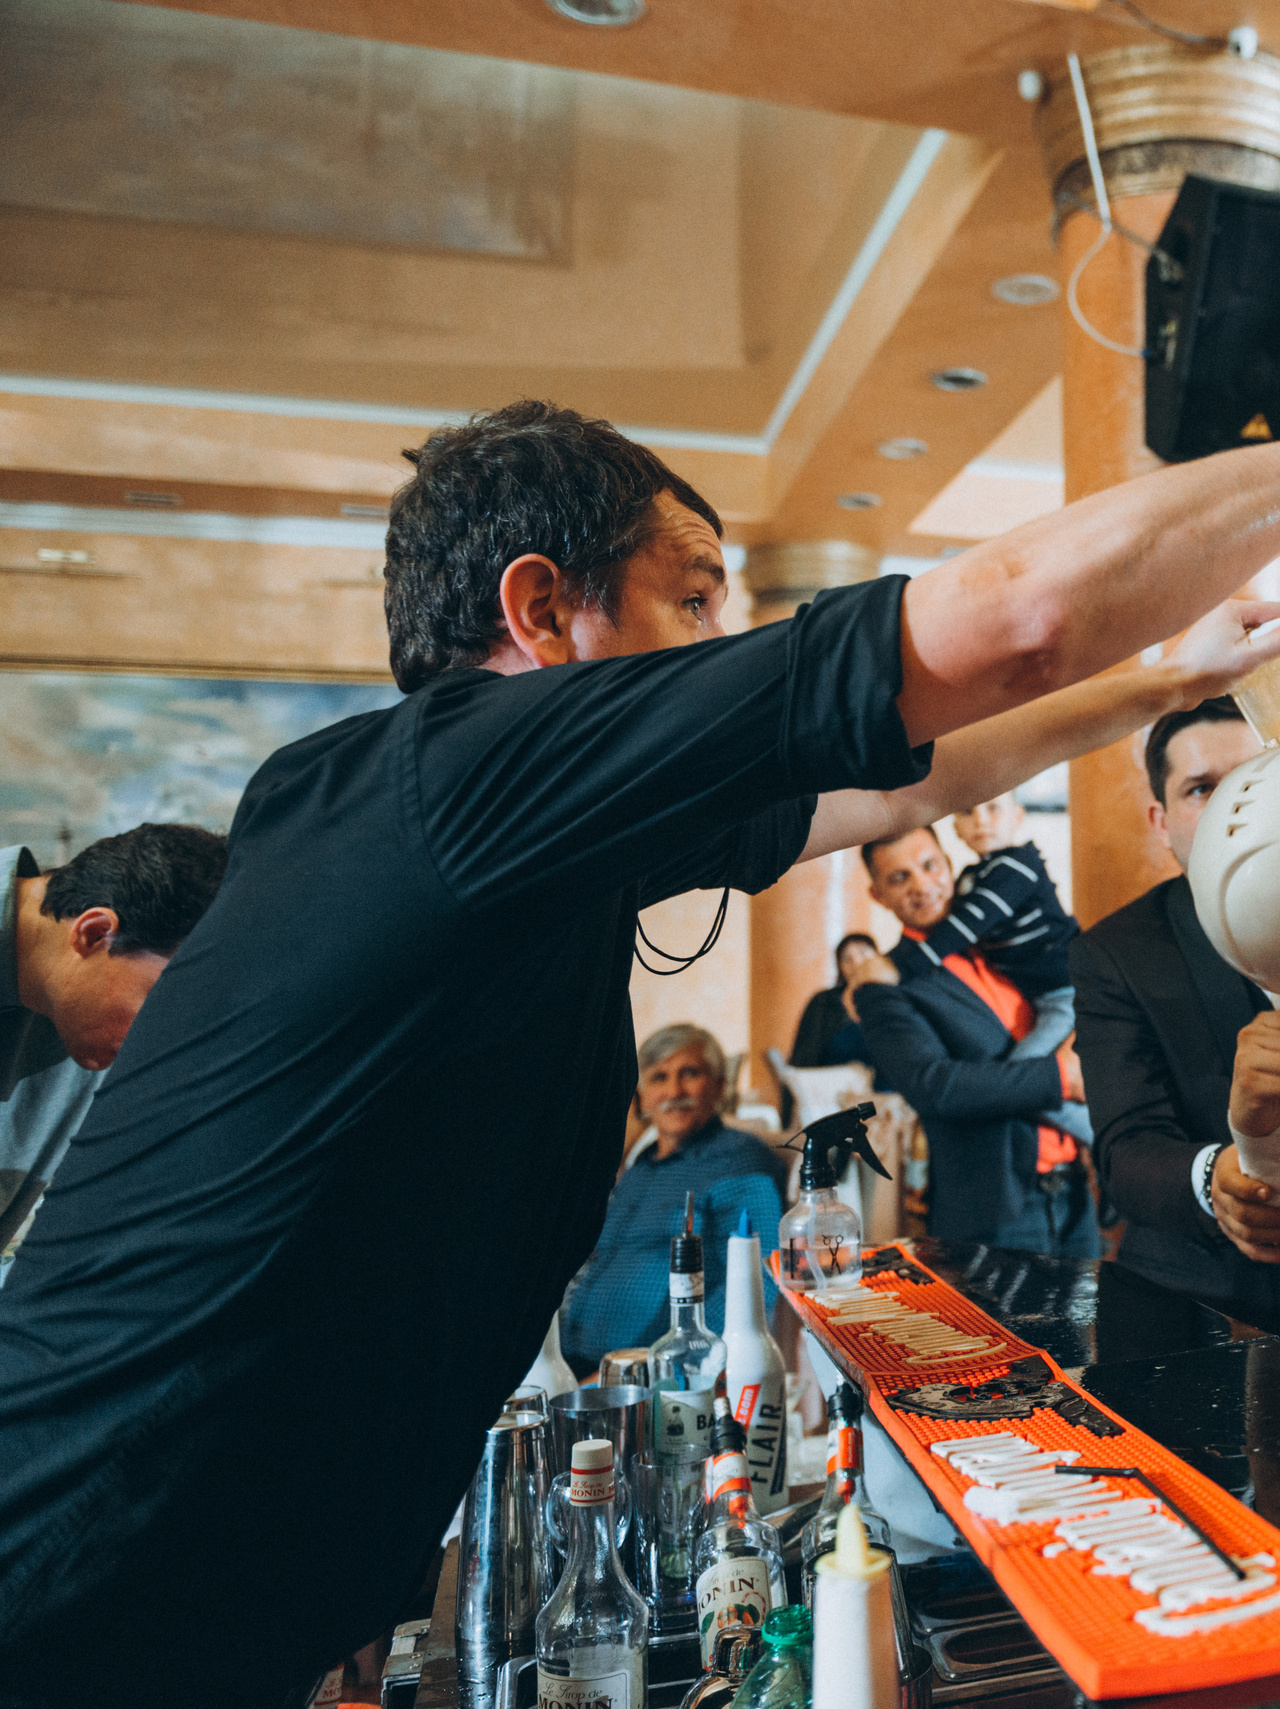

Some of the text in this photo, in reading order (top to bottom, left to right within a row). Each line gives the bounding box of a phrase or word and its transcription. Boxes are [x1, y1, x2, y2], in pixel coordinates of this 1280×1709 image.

[748, 1404, 782, 1483] FLAIR
[571, 1488, 605, 1497] MONIN
[699, 1577, 755, 1613] ONIN
[539, 1694, 613, 1709] MONIN
